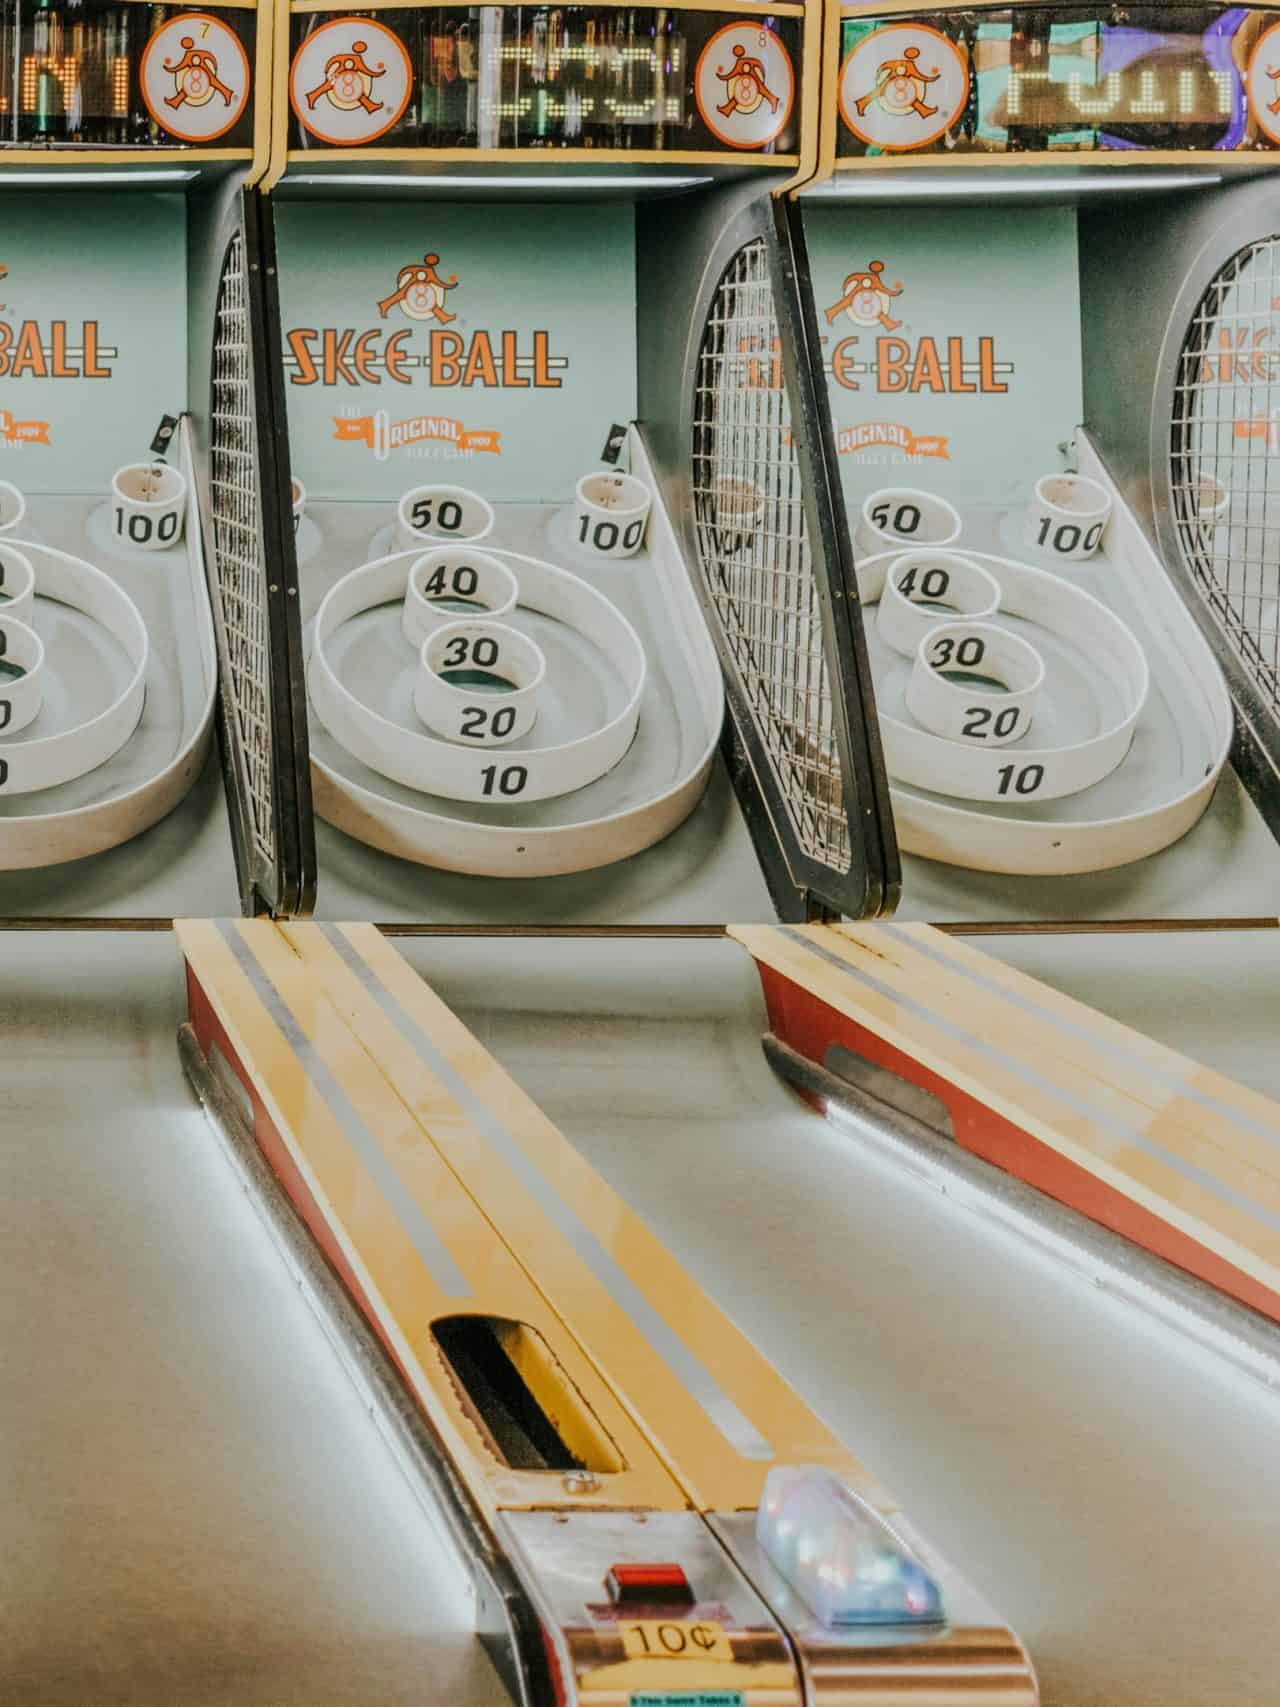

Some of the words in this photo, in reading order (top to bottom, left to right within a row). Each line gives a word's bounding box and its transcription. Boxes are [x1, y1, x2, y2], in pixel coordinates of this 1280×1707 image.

[199, 22, 211, 39] 7
[758, 31, 768, 48] 8
[286, 328, 412, 386] SKEE
[429, 329, 562, 388] BALL
[875, 336, 1008, 393] BALL
[374, 408, 461, 461] ORIGINAL
[115, 506, 179, 544] 100
[410, 499, 463, 530] 50
[870, 503, 922, 534] 50
[578, 514, 643, 552] 100
[1037, 516, 1104, 553] 100
[424, 565, 479, 597] 40
[896, 567, 951, 598] 40
[442, 637, 500, 668] 30
[929, 637, 986, 669] 30
[460, 706, 517, 739] 20
[960, 706, 1021, 739] 20
[480, 765, 529, 796] 10
[996, 764, 1046, 796] 10
[631, 1624, 717, 1654] 10¢
